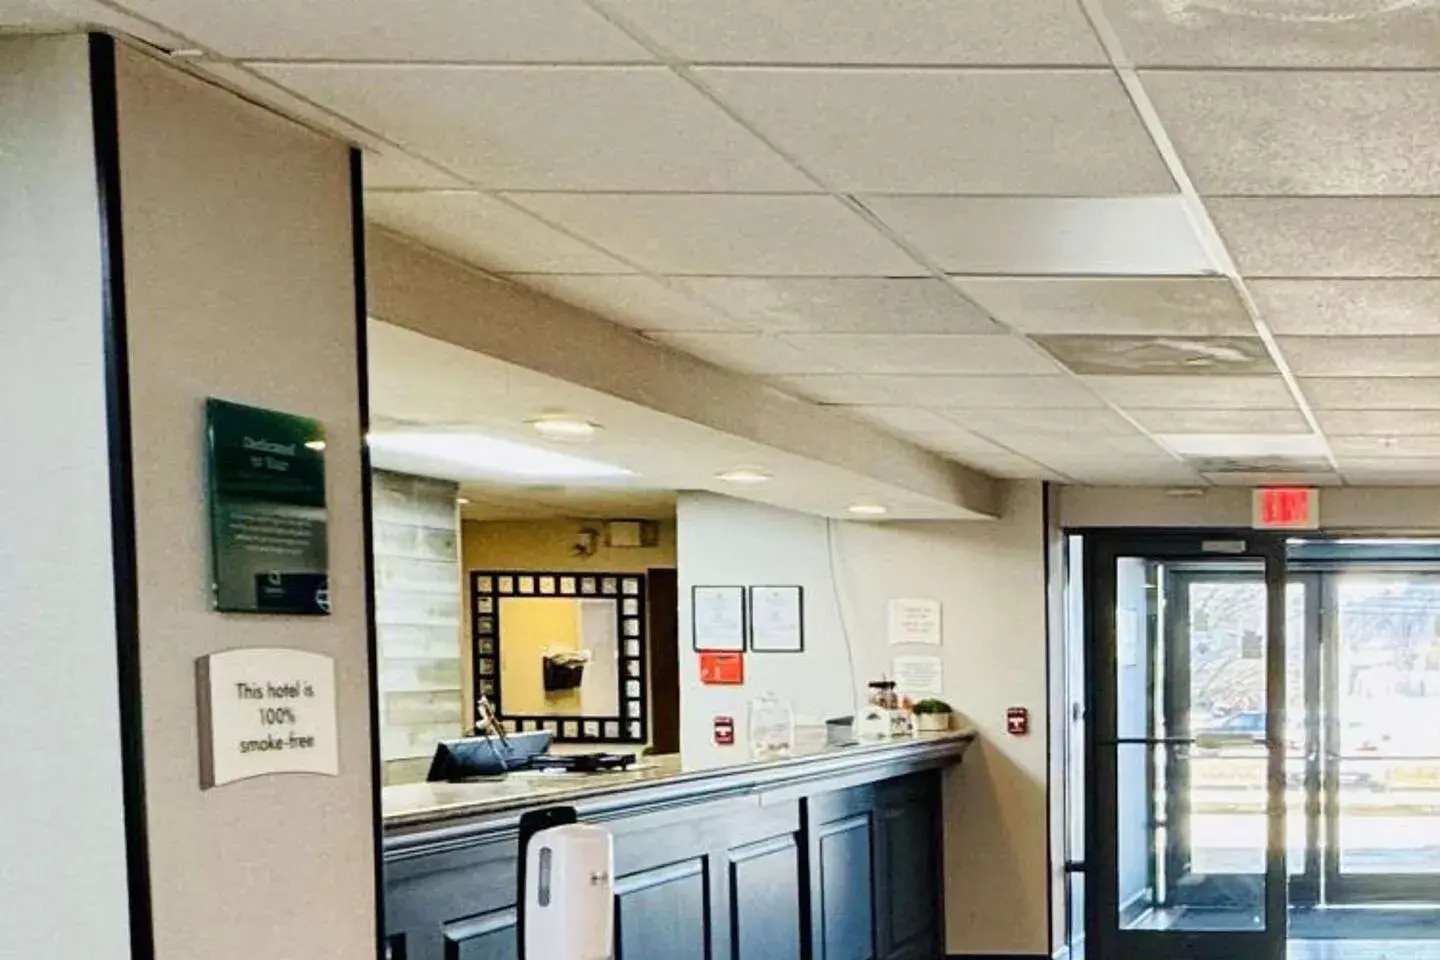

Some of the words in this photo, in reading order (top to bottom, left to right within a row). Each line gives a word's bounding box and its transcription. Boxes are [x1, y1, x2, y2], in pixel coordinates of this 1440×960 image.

[236, 682, 263, 700] This
[267, 680, 300, 699] hotel
[303, 680, 314, 698] is
[259, 706, 296, 726] 100%
[240, 731, 315, 753] smoke-free
